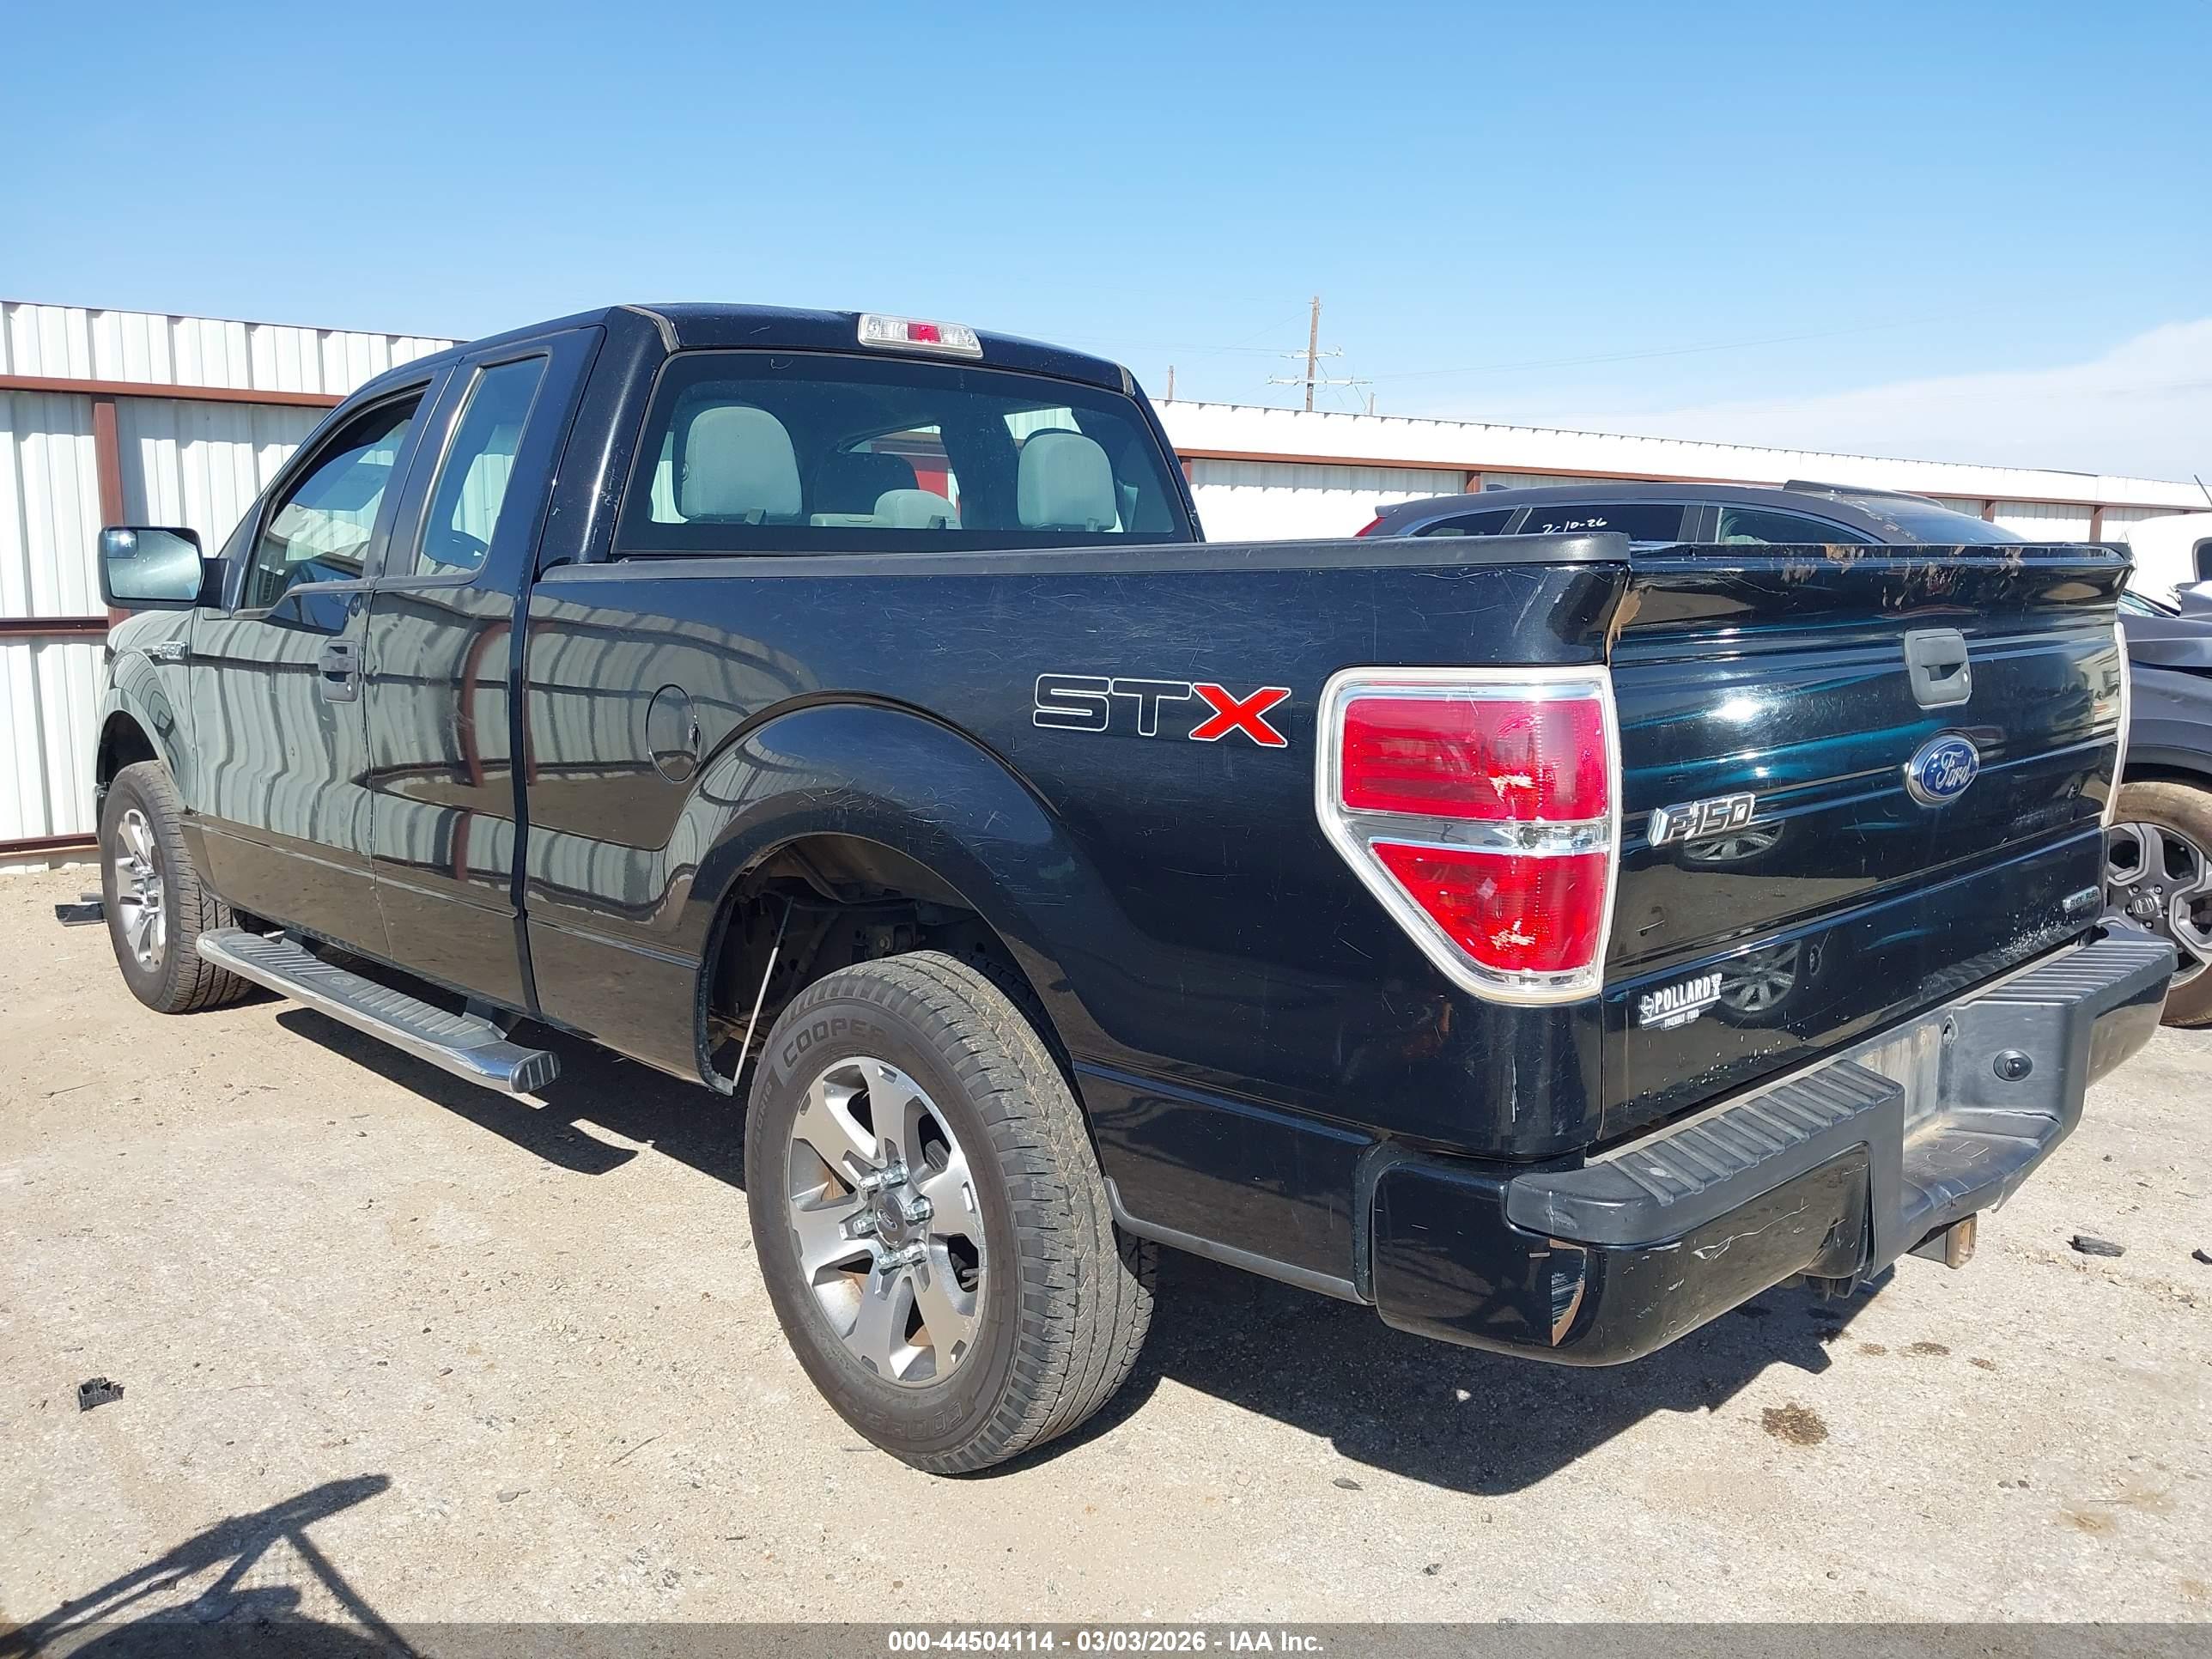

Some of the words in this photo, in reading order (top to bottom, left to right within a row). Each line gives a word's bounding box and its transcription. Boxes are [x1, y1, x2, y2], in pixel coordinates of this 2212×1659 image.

[1542, 517, 1607, 534] 2-10-26
[1033, 673, 1291, 748] STX
[1935, 750, 1972, 790] Ford
[1654, 977, 1711, 1014] POLLARD
[782, 1018, 887, 1069] COOPER
